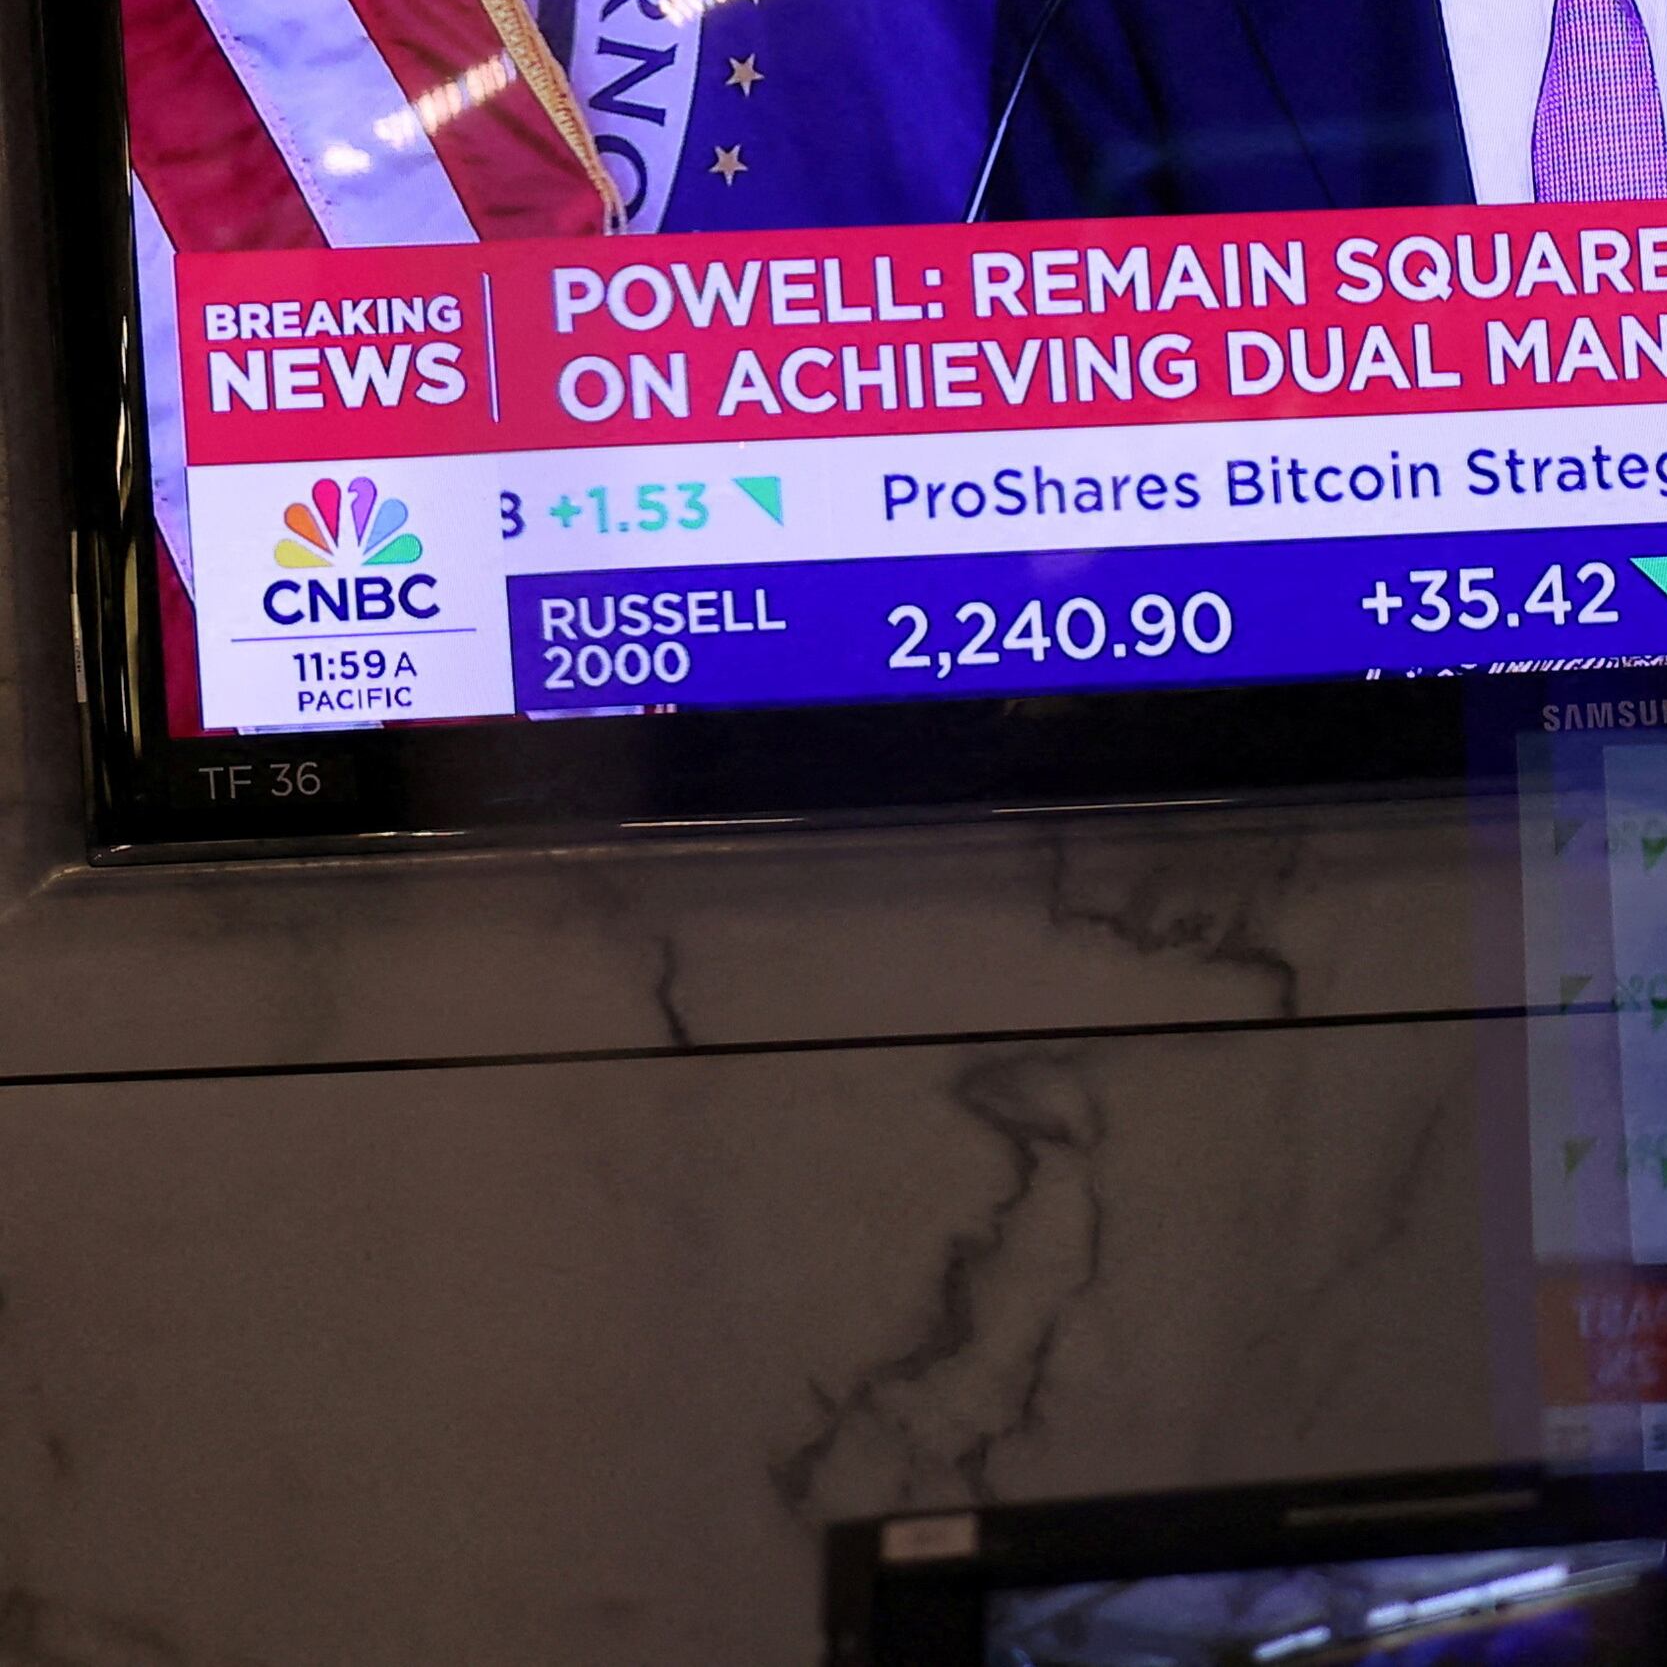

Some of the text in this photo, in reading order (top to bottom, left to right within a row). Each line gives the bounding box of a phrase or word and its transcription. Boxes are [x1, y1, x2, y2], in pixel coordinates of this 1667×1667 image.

[555, 268, 945, 335] POWELL:
[972, 239, 1308, 321] REMAIN
[204, 294, 463, 344] BREAKING
[207, 340, 468, 413] NEWS
[557, 352, 690, 425] ON
[717, 331, 1201, 420] ACHIEVING
[1228, 324, 1462, 398] DUAL
[550, 481, 710, 534] +1.53
[881, 460, 1203, 526] ProShares
[1226, 446, 1443, 510] Bitcoin
[261, 571, 442, 624] CNBC
[540, 588, 788, 644] RUSSELL
[543, 640, 692, 692] 2000
[886, 589, 1235, 679] 2,240.90
[1360, 561, 1621, 634] +35.42
[291, 648, 419, 684] 11:59 A
[295, 684, 416, 716] PACIFIC
[199, 761, 322, 803] TF 36
